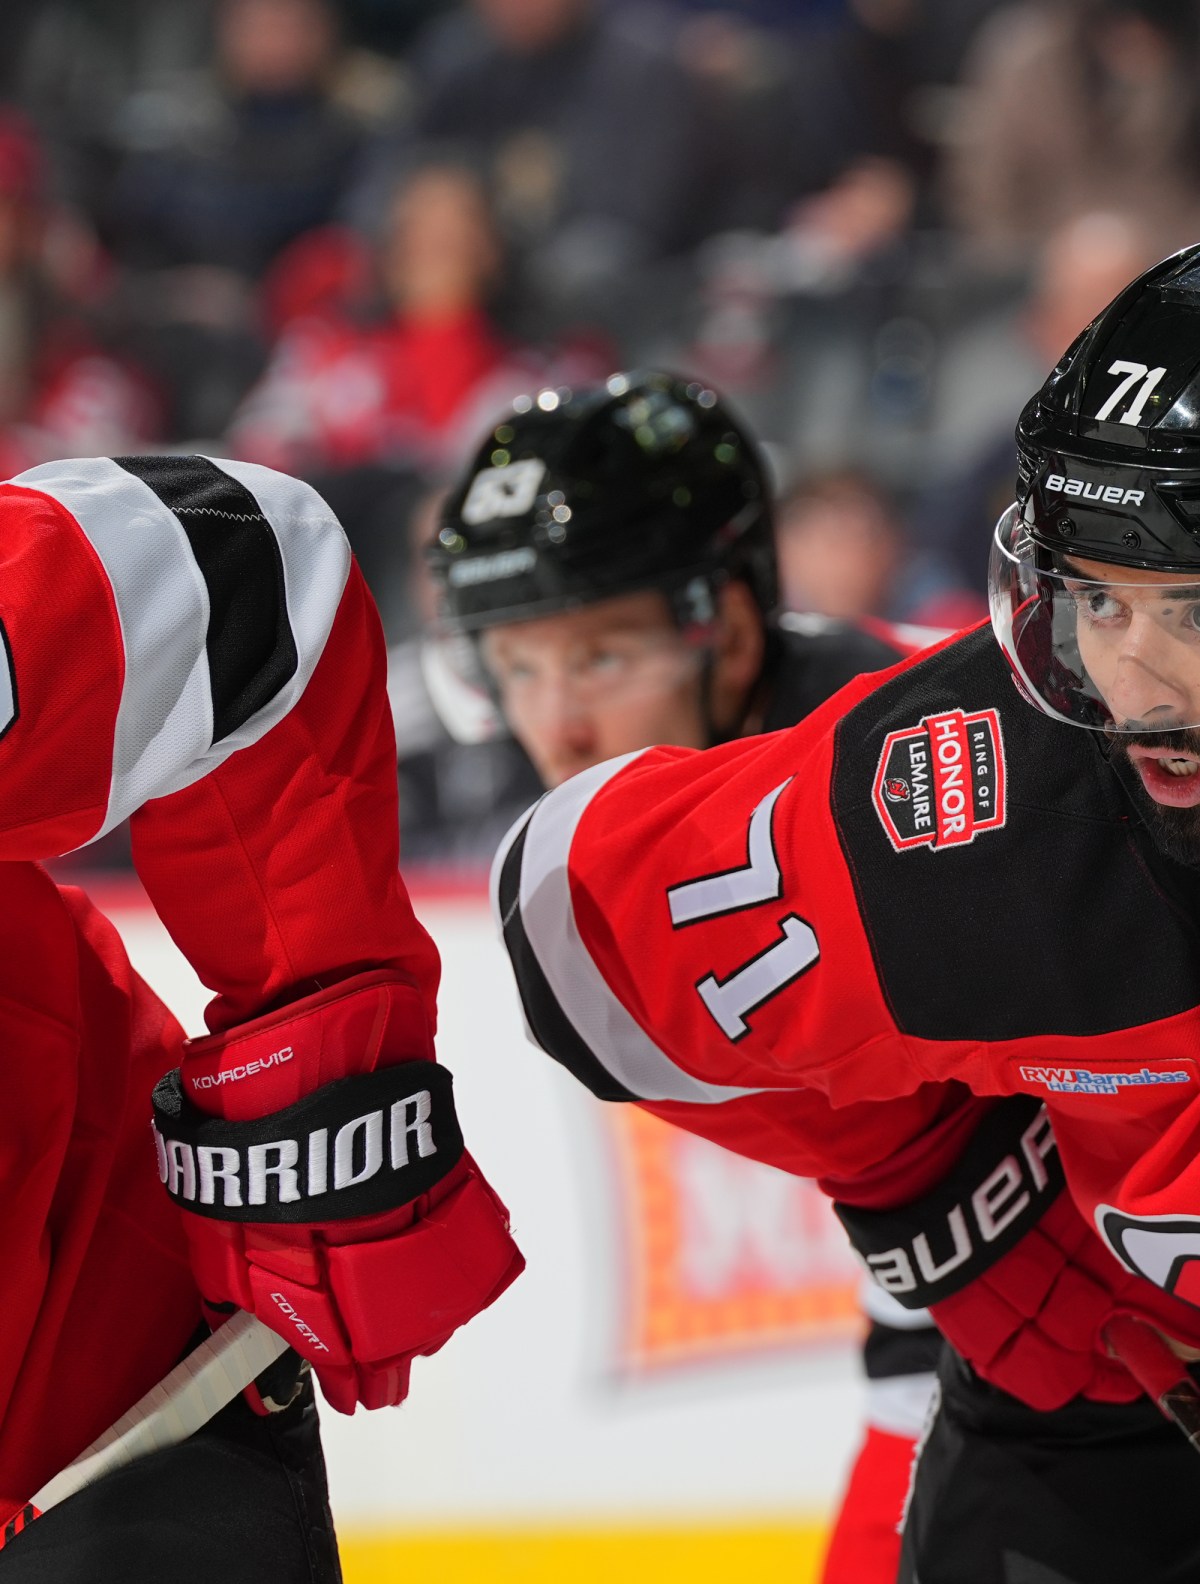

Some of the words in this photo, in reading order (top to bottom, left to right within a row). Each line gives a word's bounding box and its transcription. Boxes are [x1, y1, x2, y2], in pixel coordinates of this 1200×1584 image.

[1094, 359, 1168, 427] 71
[1045, 473, 1146, 507] BAUER
[934, 718, 966, 839] HONOR
[973, 731, 989, 776] RING
[908, 741, 931, 830] LEMAIRE
[978, 785, 990, 809] OF
[665, 772, 821, 1045] 71
[191, 1046, 294, 1090] KOVACEVIC
[1048, 1081, 1119, 1095] HEALTH
[270, 1292, 330, 1352] COVERT
